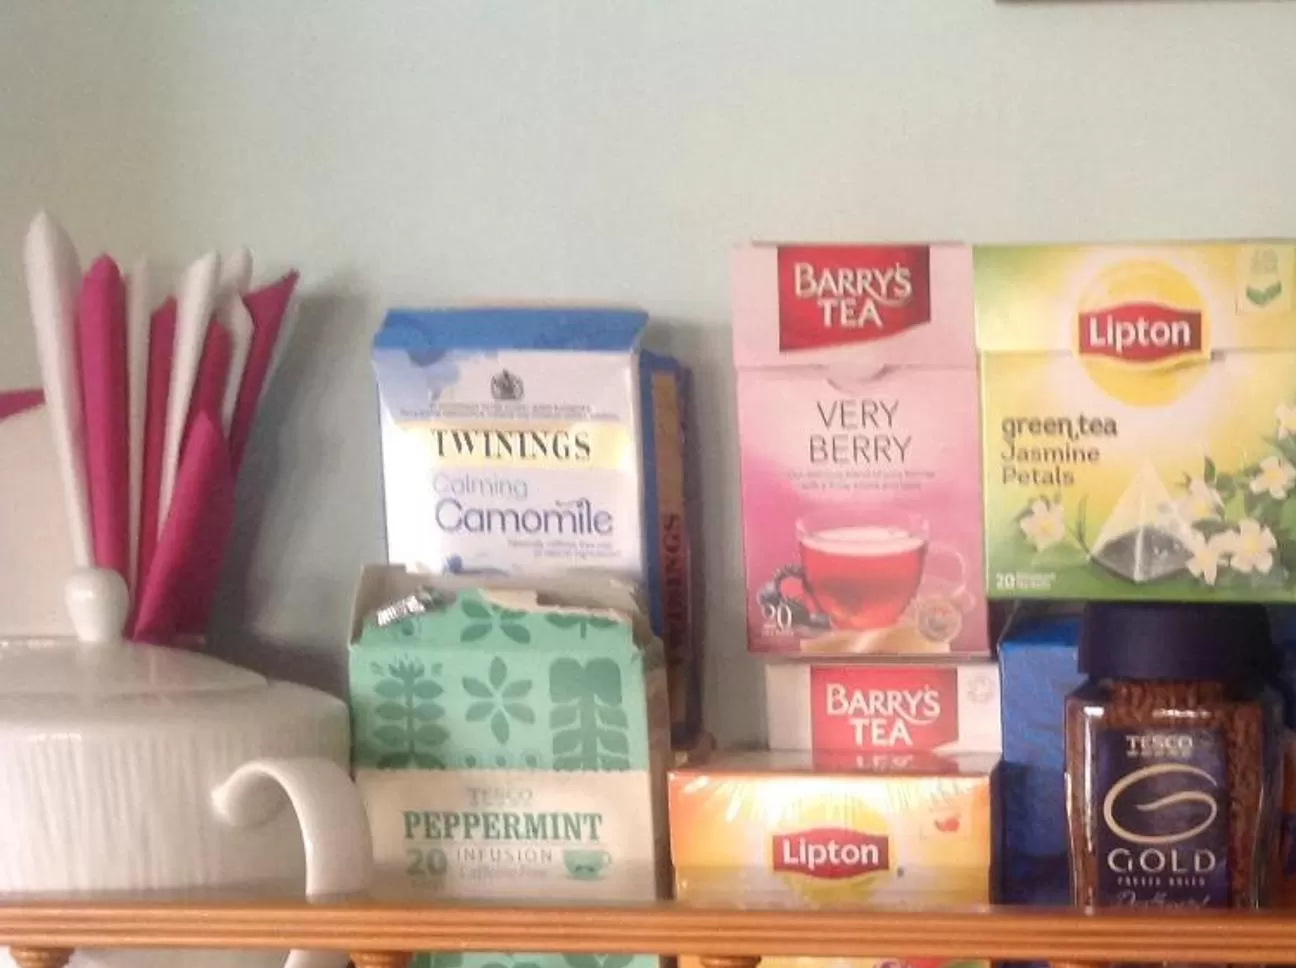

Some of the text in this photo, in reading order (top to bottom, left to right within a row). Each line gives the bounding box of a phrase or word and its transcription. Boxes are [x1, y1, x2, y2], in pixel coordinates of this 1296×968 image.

[793, 262, 913, 307] BARRY'S
[817, 298, 884, 328] TEA
[1089, 316, 1191, 352] Lipton
[816, 400, 900, 430] VERY
[1001, 412, 1118, 440] green tea
[431, 428, 591, 461] TWININGS
[808, 434, 913, 464] BERRY
[1001, 441, 1100, 463] Jasmine
[432, 471, 528, 499] Calming
[1001, 465, 1075, 486] Petals
[435, 497, 614, 535] Camomile
[760, 603, 793, 631] 20
[826, 682, 941, 725] BARRY'S
[850, 718, 913, 747] TEA
[1125, 734, 1193, 749] TESCO
[402, 811, 603, 841] PEPPERMINT
[406, 848, 448, 877] 20
[457, 847, 552, 863] INFUSION
[783, 840, 879, 870] Lipton
[1107, 848, 1216, 873] GOLD
